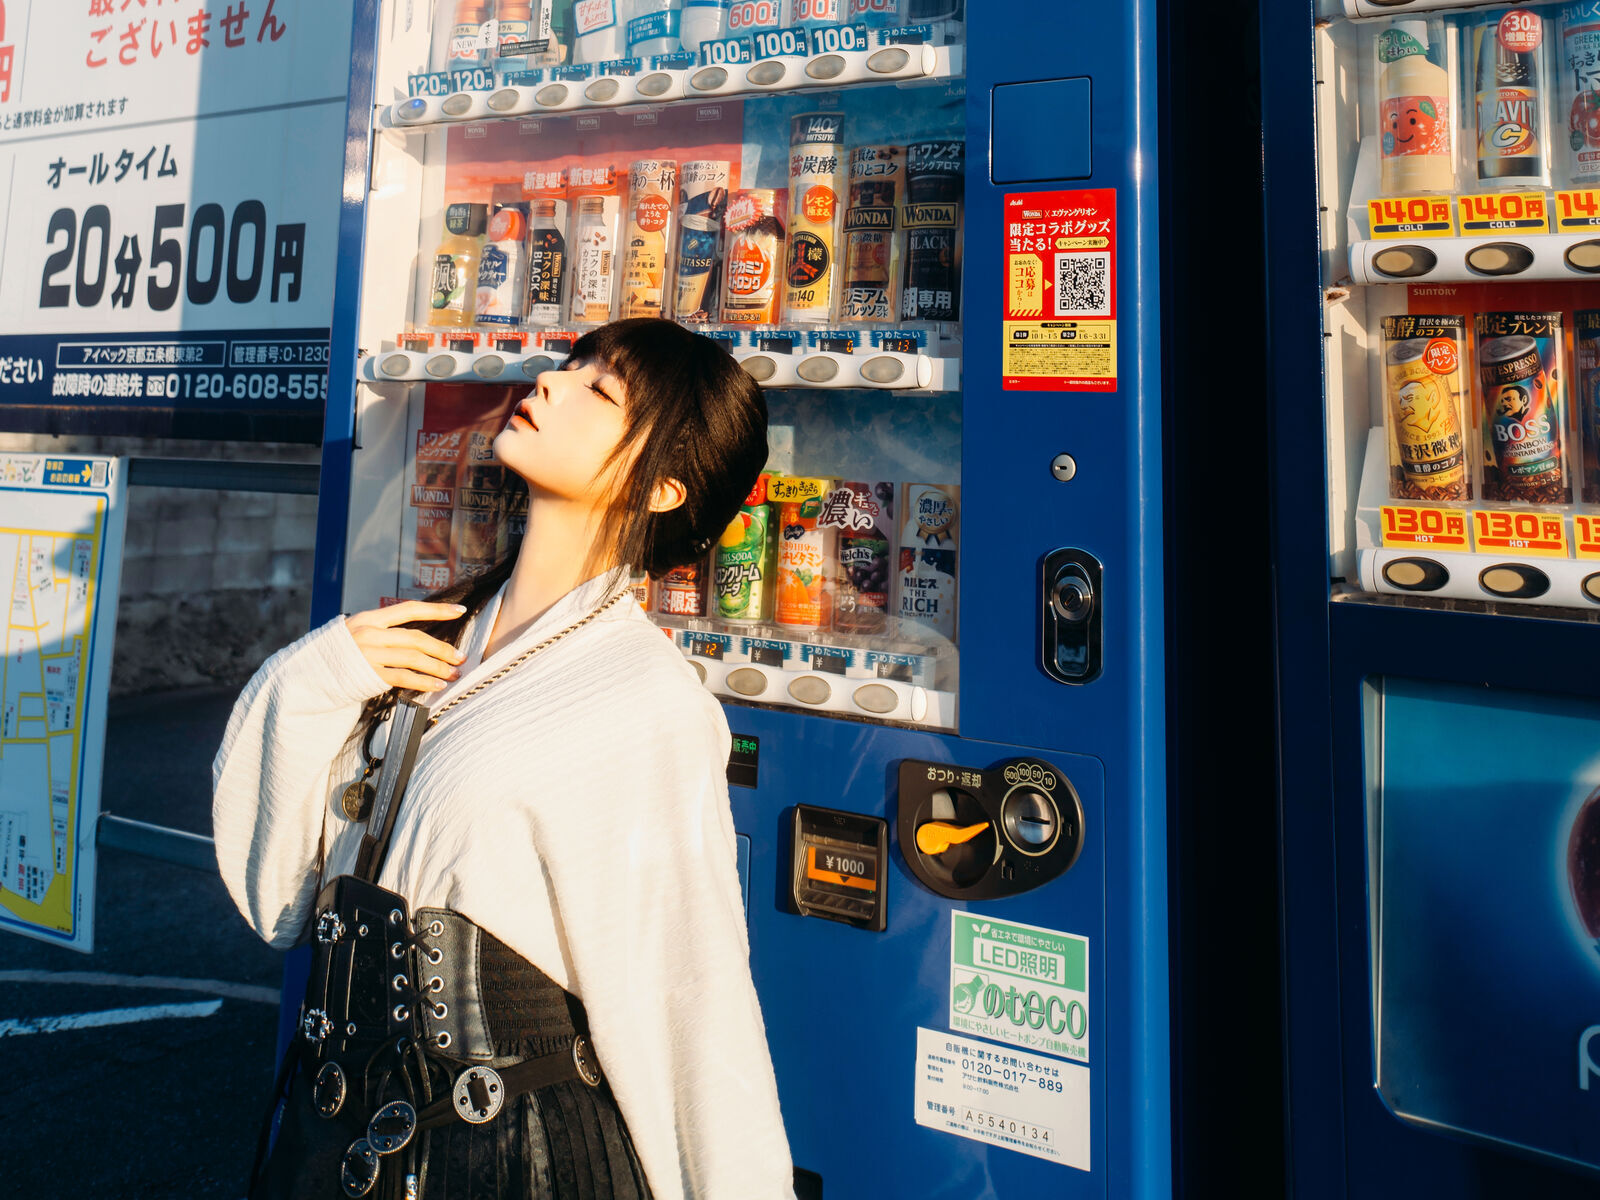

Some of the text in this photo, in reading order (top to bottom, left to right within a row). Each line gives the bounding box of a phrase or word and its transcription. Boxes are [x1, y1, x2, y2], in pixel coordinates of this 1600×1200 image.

[756, 30, 806, 56] 100円
[814, 26, 866, 53] 100円
[702, 42, 750, 64] 100円
[410, 76, 448, 96] 120円
[453, 70, 493, 92] 120円
[806, 133, 836, 142] MITSUYA
[1491, 122, 1522, 148] C
[47, 143, 179, 189] オールタイム
[806, 195, 834, 206] レモン
[1371, 198, 1450, 224] 140円
[1460, 195, 1544, 222] 140円
[848, 209, 889, 226] WONDA
[905, 207, 952, 225] WONDA
[1051, 208, 1098, 218] エヴァンゲリオン
[1009, 218, 1111, 238] 限定コラボグッズ
[1398, 223, 1424, 232] COLD
[1489, 220, 1517, 229] COLD
[910, 235, 949, 250] BLACK
[39, 199, 307, 313] 20分500円
[530, 251, 543, 291] BLACK
[539, 250, 553, 302] コクの深味
[1025, 266, 1036, 297] 応募は
[1413, 287, 1457, 297] SUNTORY
[1419, 318, 1461, 327] 贅沢を極めた
[1427, 355, 1458, 369] ブレンド
[1430, 347, 1451, 358] 限定
[1498, 353, 1538, 376] ESPRESSO
[52, 373, 144, 397] 故障時の連絡先
[1494, 414, 1551, 442] BOSS
[1403, 434, 1460, 460] 贅沢微糖
[1413, 459, 1456, 473] 豊醇のコク
[413, 485, 450, 503] WONDA
[855, 490, 881, 517] ギュッと
[818, 490, 873, 529] 濃い
[1384, 507, 1464, 535] 130円
[1476, 512, 1562, 540] 130円
[1414, 534, 1434, 543] HOT
[1509, 539, 1530, 548] HOT
[719, 582, 742, 598] ソーダ
[904, 576, 939, 590] カルピス
[909, 588, 927, 597] THE
[902, 596, 938, 613] RICH
[1004, 766, 1054, 786] 500 100 50 10
[825, 854, 865, 876] ¥1000
[991, 927, 1066, 952] 省エネで環境にやさしい
[980, 942, 1059, 981] LED照明
[982, 982, 1087, 1039] のむeco
[953, 1016, 1087, 1059] 環境にやさしいヒートポンプ自動販売機
[945, 1042, 1059, 1078] 自販機に関するお問い合わせは
[927, 1100, 955, 1116] 管理番号
